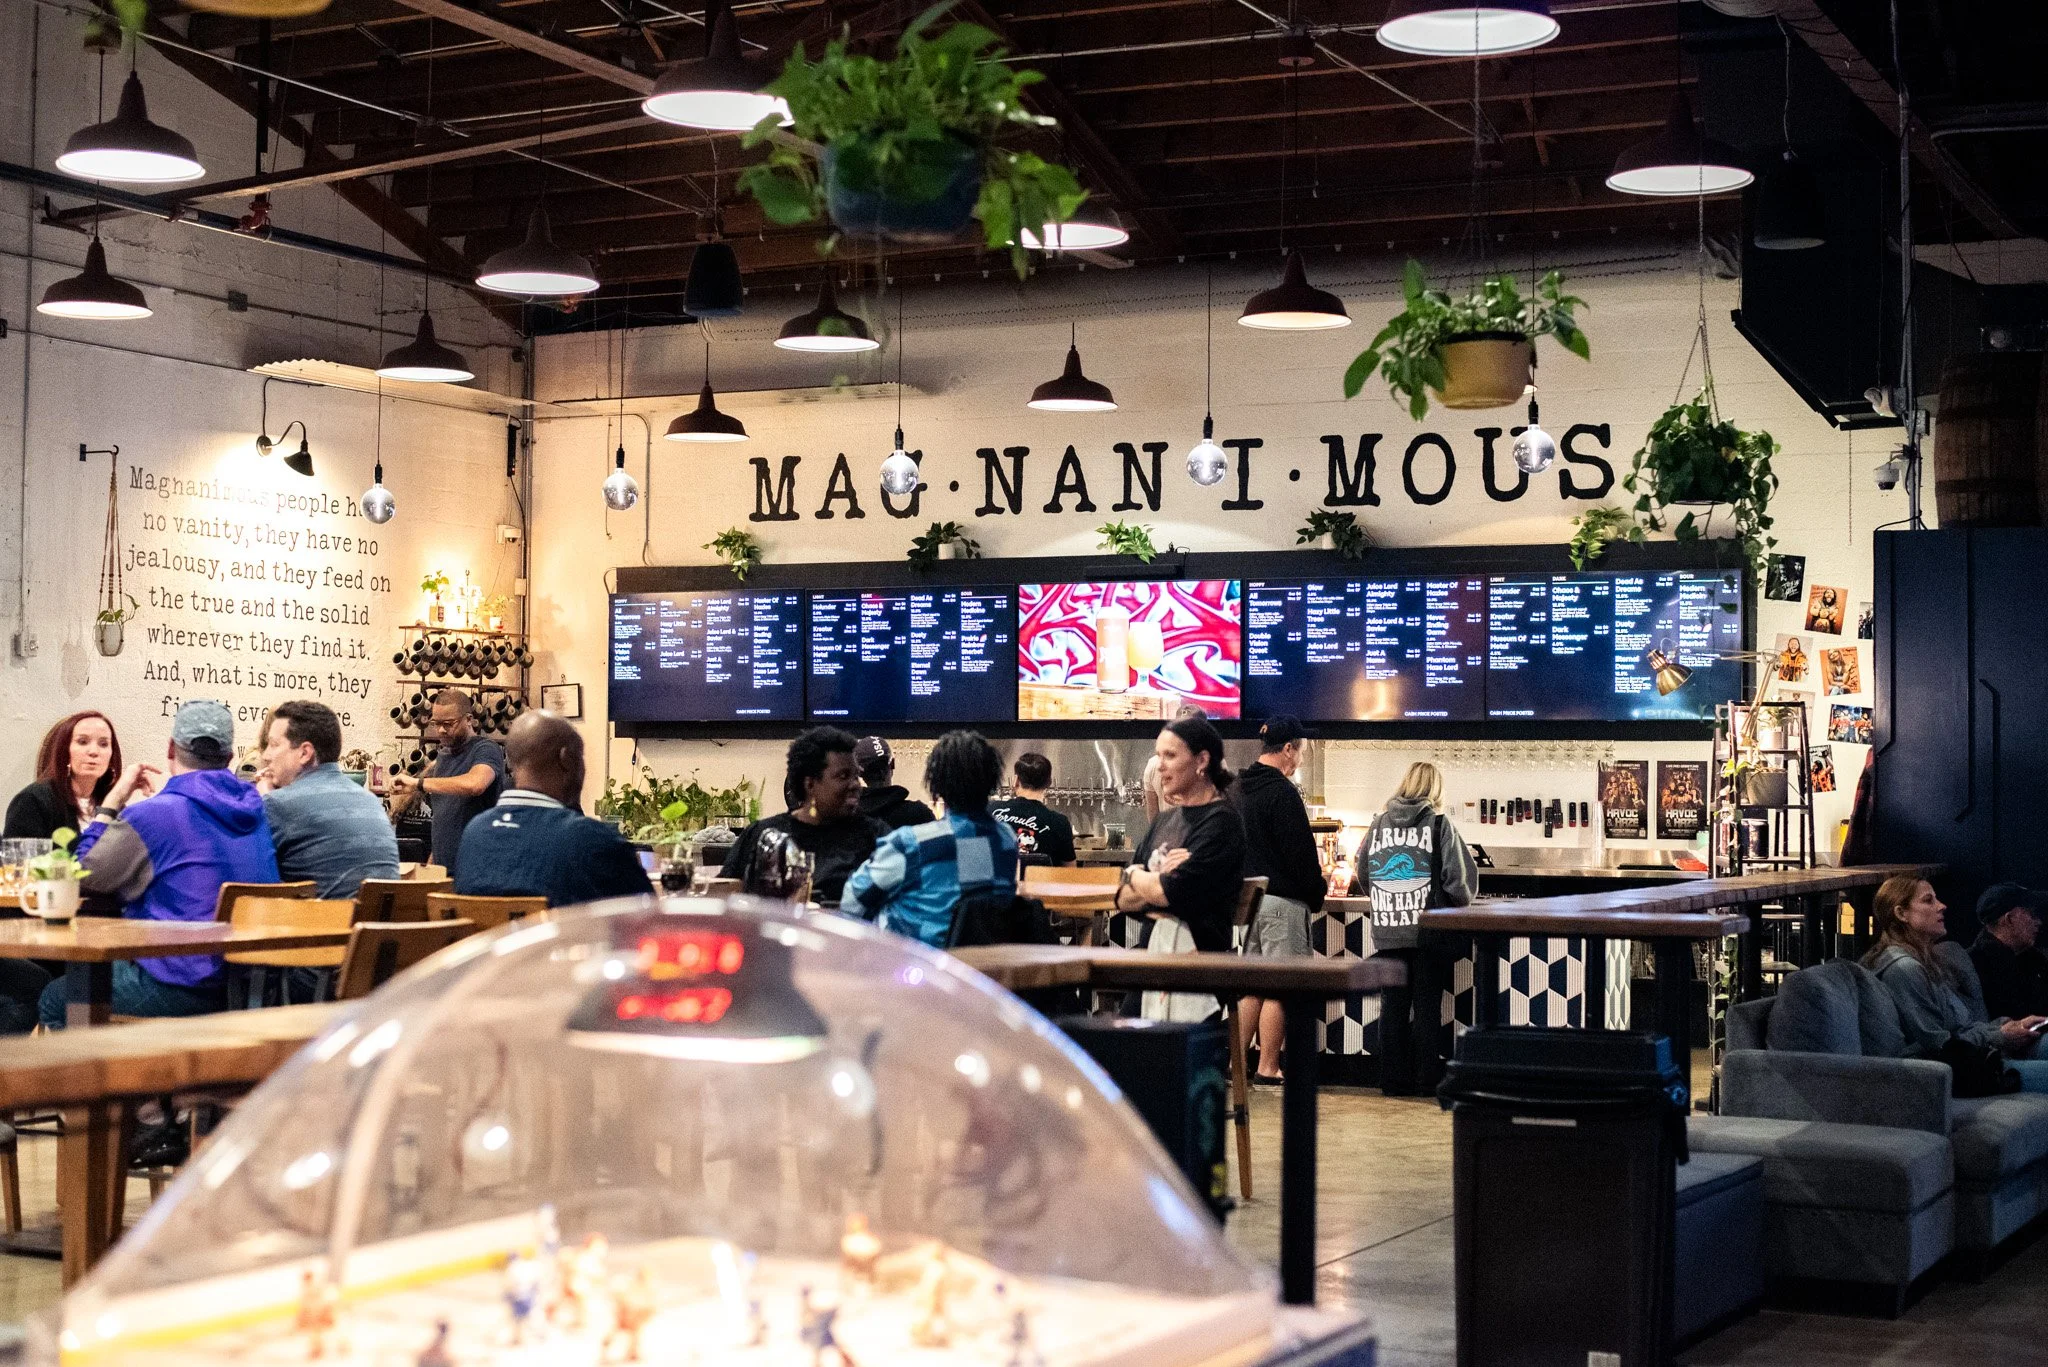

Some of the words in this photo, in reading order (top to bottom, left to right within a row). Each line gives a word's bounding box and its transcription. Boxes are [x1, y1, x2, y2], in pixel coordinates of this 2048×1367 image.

[276, 490, 340, 516] people
[143, 512, 166, 532] no
[173, 514, 249, 547] vanity,
[254, 524, 299, 552] they
[306, 528, 352, 552] have
[358, 538, 378, 556] no
[126, 544, 225, 582] jealousy,
[231, 560, 266, 580] and
[273, 563, 316, 590] they
[322, 567, 364, 590] feed
[370, 574, 391, 592] on
[148, 588, 184, 608] the
[190, 590, 234, 614] true
[241, 598, 275, 618] and
[282, 600, 315, 622] the
[320, 606, 370, 626] solid
[148, 624, 244, 650] wherever
[250, 632, 294, 659] they
[300, 636, 342, 658] find
[348, 642, 371, 660] it.
[144, 660, 186, 688] And,
[192, 664, 242, 686] what
[248, 666, 267, 688] is
[274, 671, 322, 696] more,
[328, 675, 372, 698] they
[992, 808, 1040, 831] Formula
[1607, 809, 1638, 818] HAVOC
[1615, 818, 1639, 827] HAZE
[1666, 809, 1697, 818] HAVOC
[1666, 819, 1672, 827] &
[1674, 818, 1697, 827] HAZE
[1369, 826, 1433, 856] ARUBA
[1371, 886, 1394, 911] ONE
